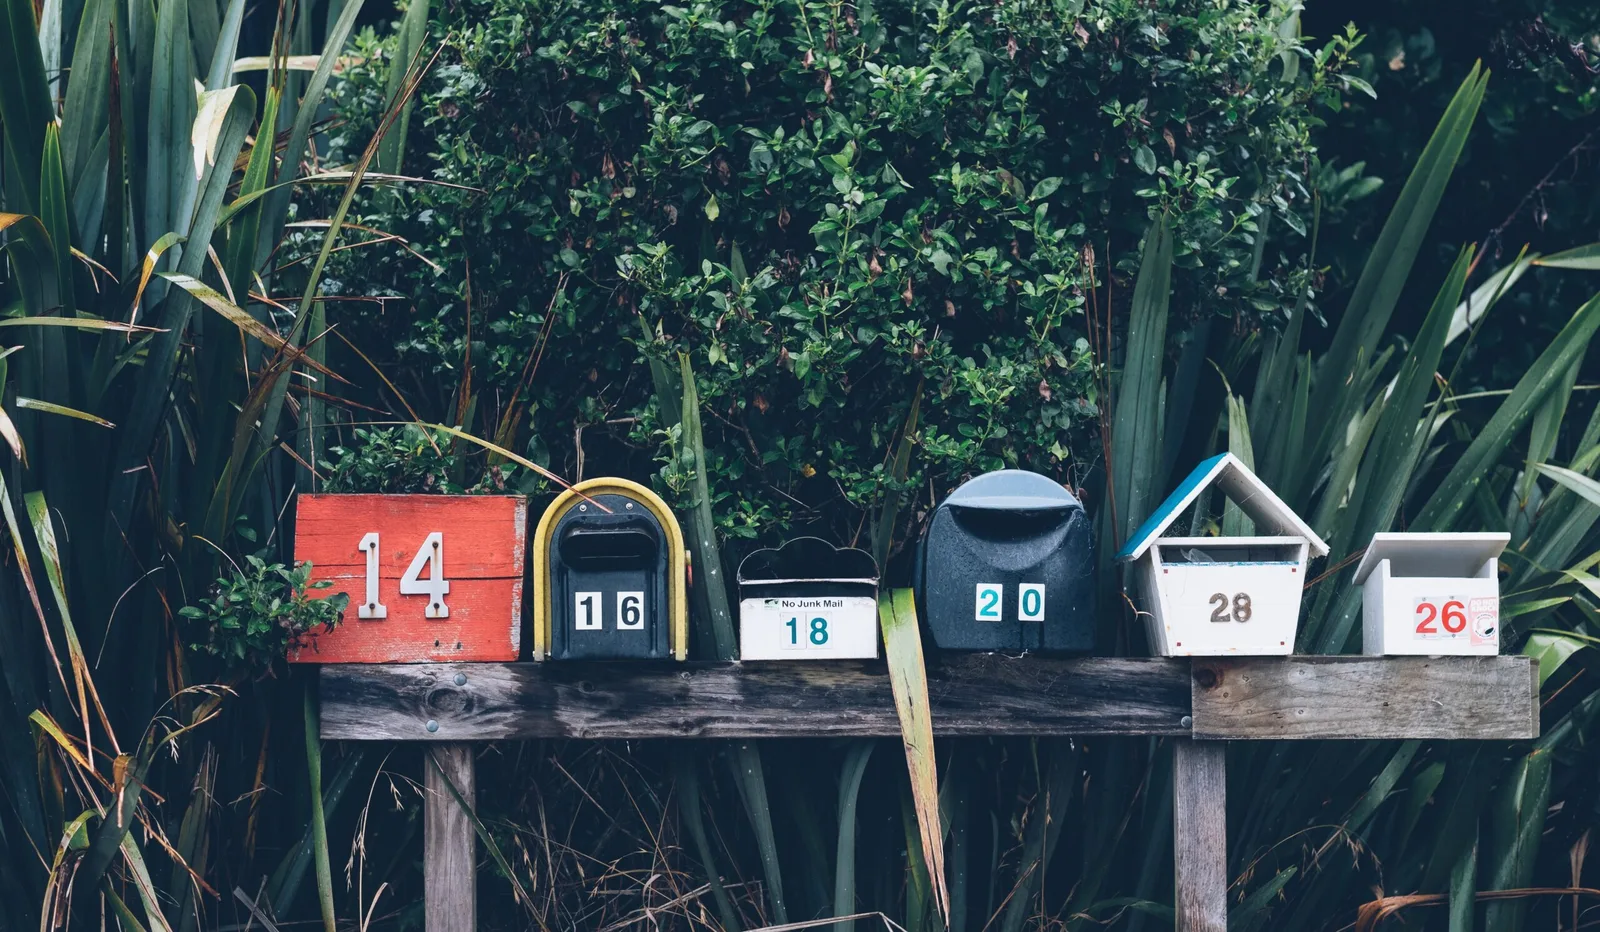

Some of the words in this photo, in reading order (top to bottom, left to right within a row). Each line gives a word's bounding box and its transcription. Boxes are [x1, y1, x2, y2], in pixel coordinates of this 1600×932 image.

[358, 531, 450, 619] 14
[781, 600, 796, 608] No
[797, 600, 822, 608] Junk
[823, 599, 843, 608] Mail
[1208, 592, 1253, 623] 28
[1415, 600, 1467, 634] 26
[785, 617, 829, 645] 18
